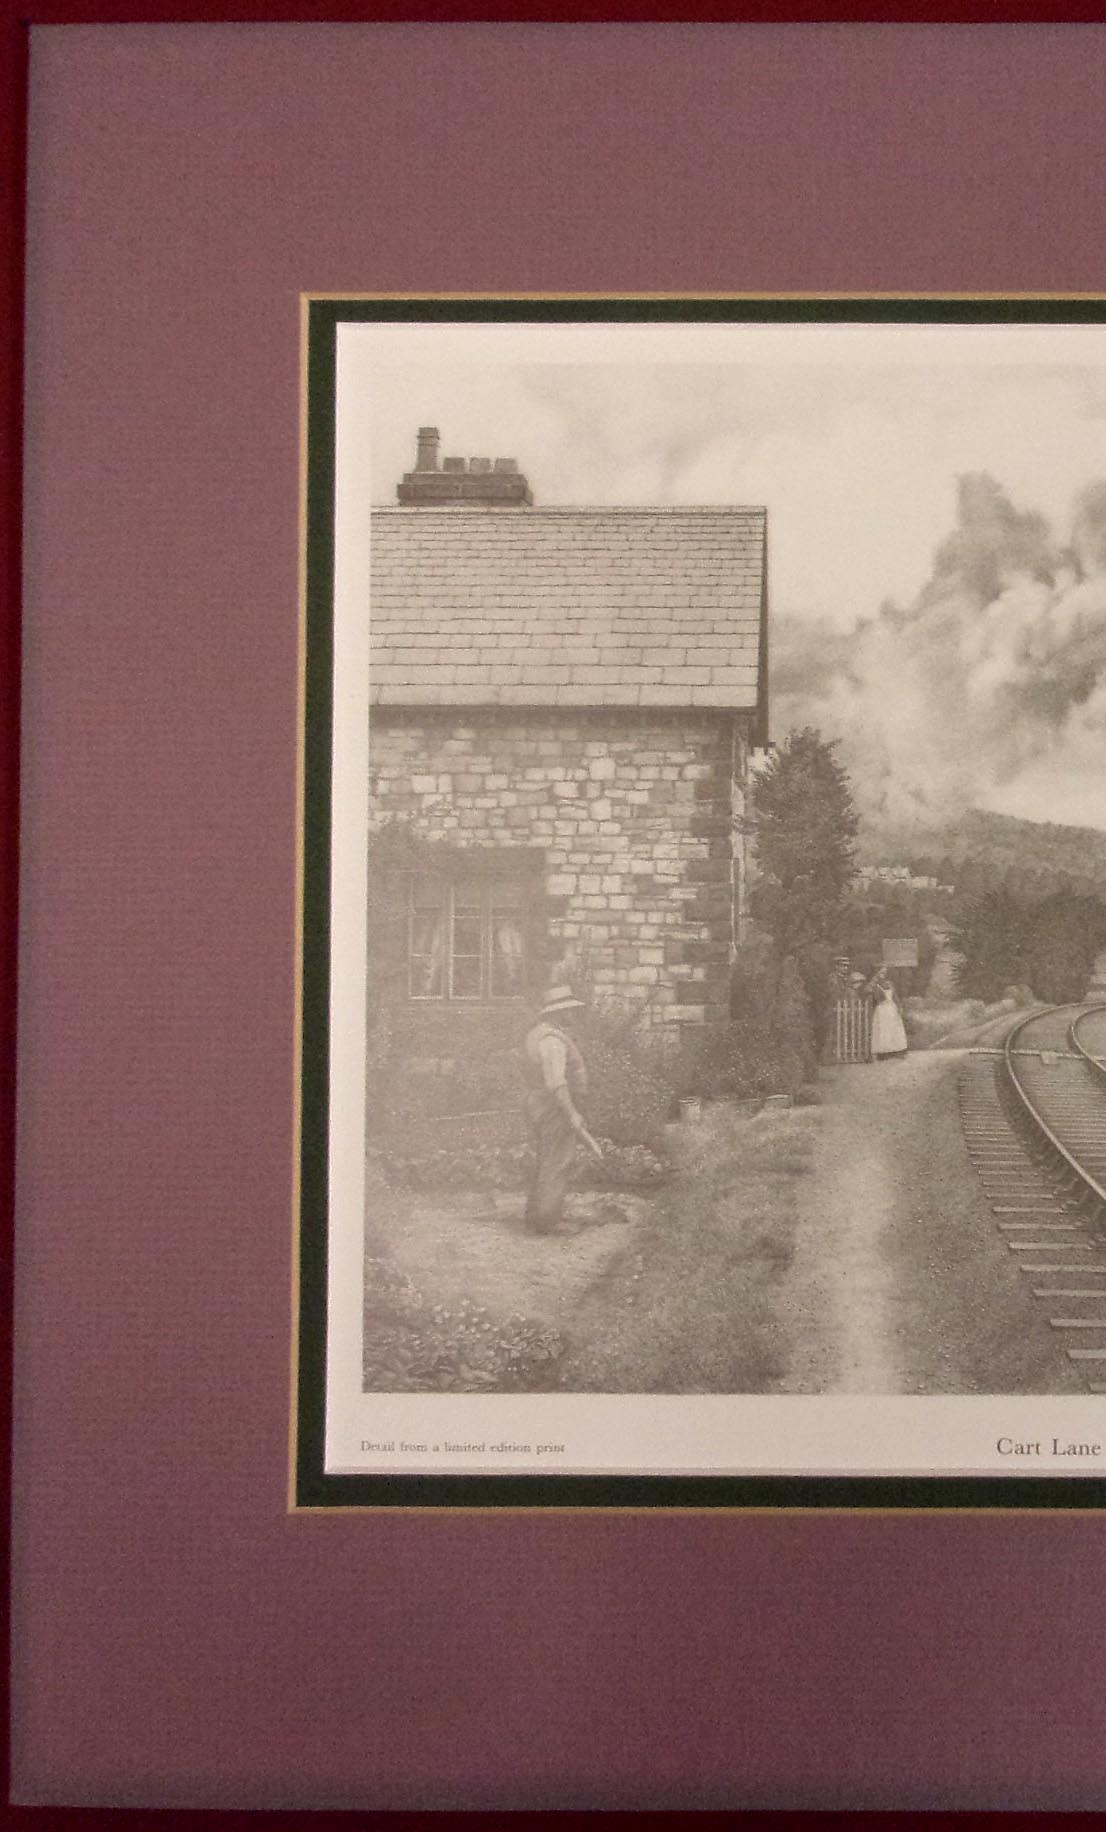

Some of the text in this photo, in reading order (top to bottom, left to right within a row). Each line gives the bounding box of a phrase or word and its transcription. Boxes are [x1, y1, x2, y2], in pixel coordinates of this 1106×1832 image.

[360, 1440, 565, 1455] Detail from a limited edition print
[997, 1437, 1041, 1455] Cart
[1052, 1438, 1101, 1456] Lane
